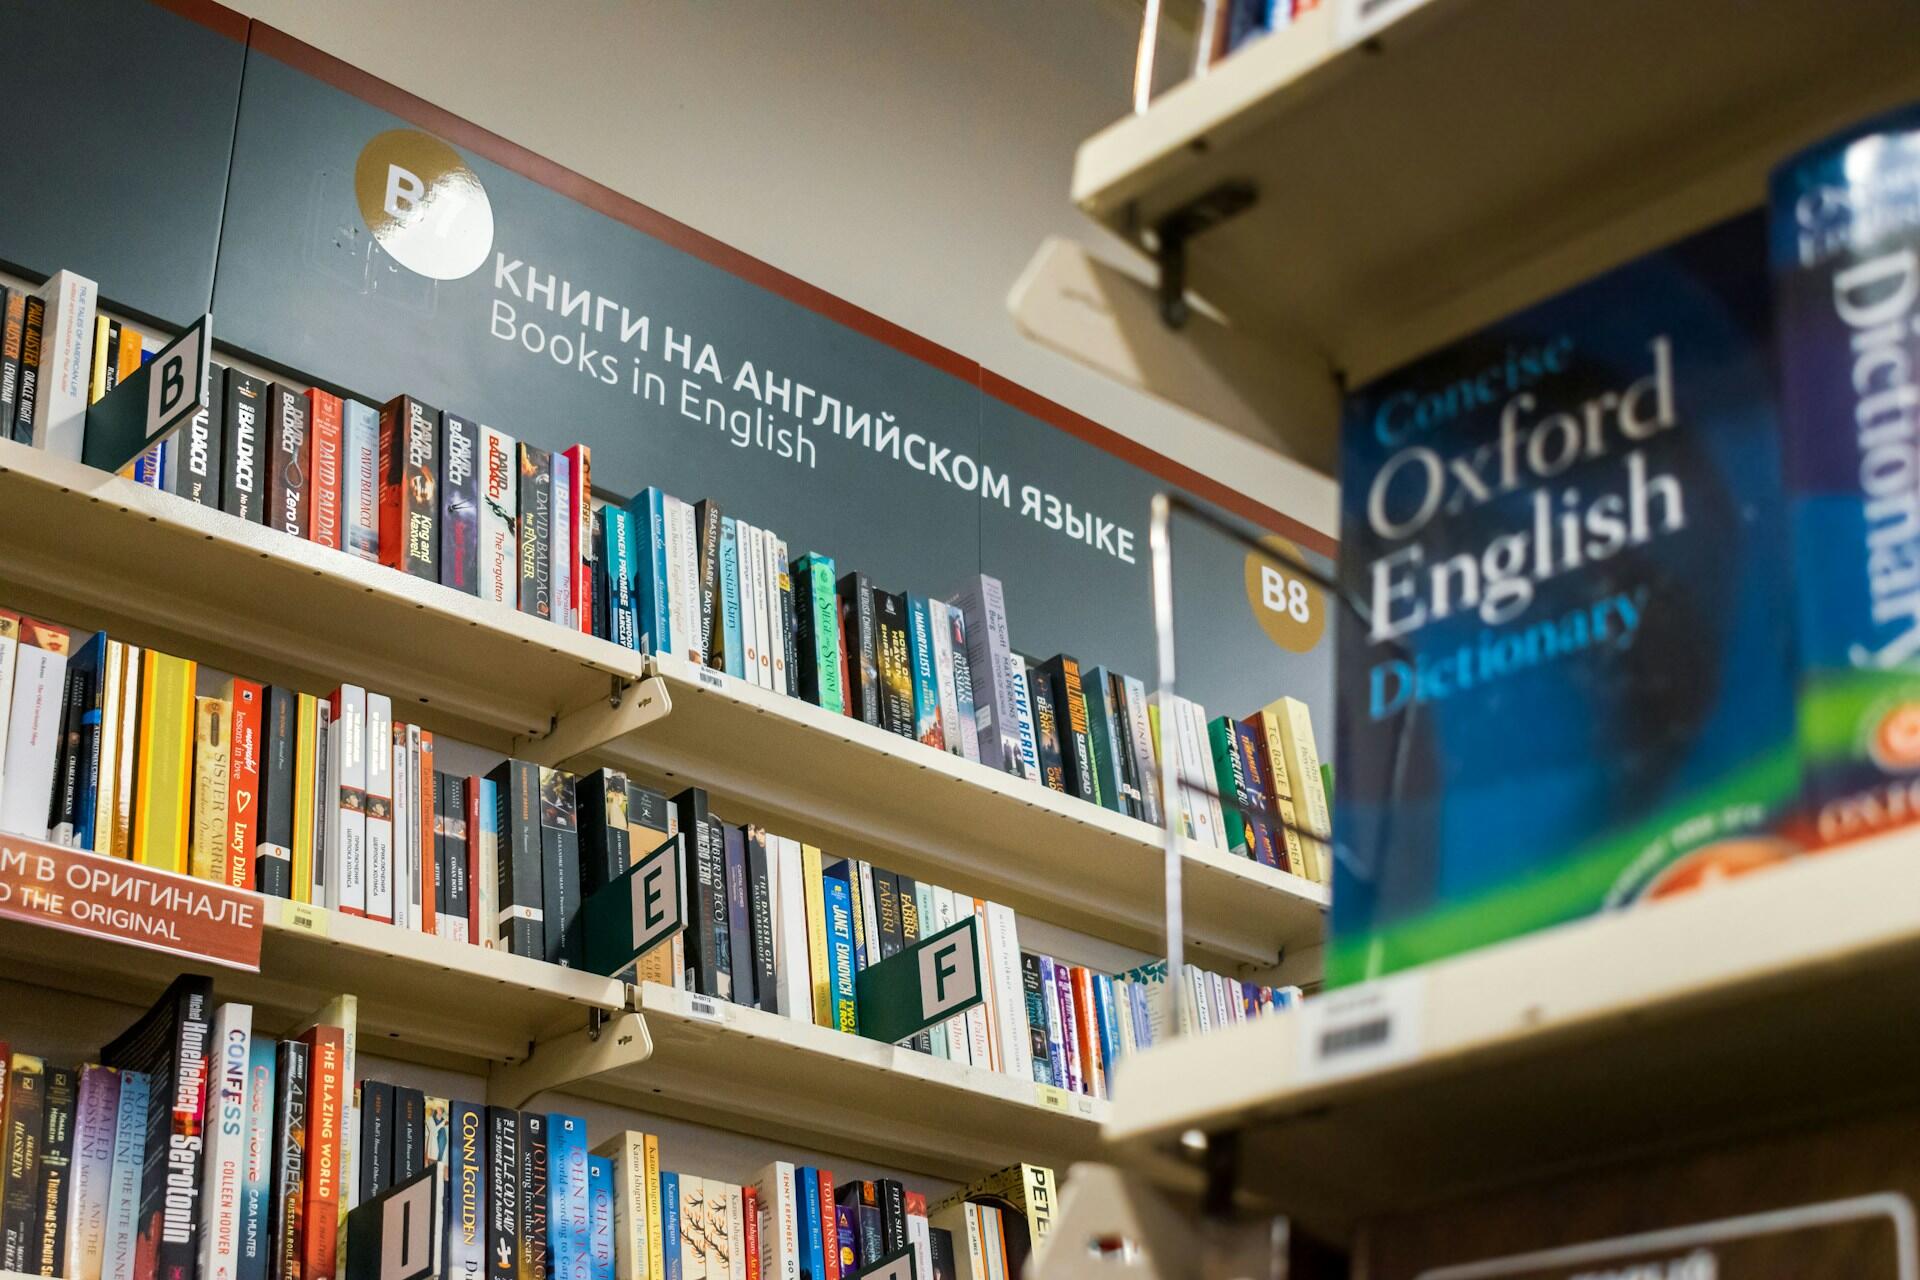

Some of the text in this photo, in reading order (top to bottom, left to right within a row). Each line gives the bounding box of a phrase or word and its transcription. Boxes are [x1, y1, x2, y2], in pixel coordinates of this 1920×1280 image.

[76, 306, 85, 328] TALES
[79, 286, 87, 306] TRUE
[4, 318, 20, 360] AUSTER
[19, 302, 43, 425] PAUL AUSTER ORACLE NIGHT
[72, 341, 82, 381] AMERICAN
[69, 381, 78, 398] LIFE
[160, 355, 184, 418] B
[490, 299, 816, 469] Books in English
[494, 252, 1136, 564] КНИГИ НА АНГЛИЙСКОМ ЯЗЫКЕ
[1374, 335, 1575, 447] Concise
[236, 408, 255, 493] BALDACCI
[319, 437, 336, 486] DAVID
[410, 402, 422, 468] BALDACCI
[421, 419, 432, 461] DAVID
[449, 418, 462, 486] BALDACCI
[461, 435, 472, 478] DAVID
[489, 434, 500, 500] BALDACCI
[1366, 335, 1677, 540] Oxford
[360, 446, 372, 528] DAVID BALDACCI
[498, 451, 509, 490] DAVID
[286, 488, 300, 520] Zero
[410, 511, 421, 558] Maxwell
[537, 489, 548, 541] DAVID
[492, 531, 505, 603] The Forgotten
[616, 513, 631, 608] BROKEN PROMISE
[723, 545, 737, 600] Sebastian
[1367, 450, 1685, 642] English
[701, 507, 718, 661] SEBASTIAN BARRY DAYS WITHOUT
[1261, 566, 1310, 624] B8
[625, 610, 634, 650] LINWOOD
[914, 610, 931, 682] IMMORTALISTS
[1368, 584, 1649, 720] Dictionary
[824, 648, 836, 693] STORM
[1012, 673, 1036, 769] STEVE BERRY
[1036, 695, 1050, 738] BERRY
[1065, 674, 1088, 734] BILLINGHAM
[233, 710, 247, 780] lessons love
[1076, 733, 1092, 795] SLEEPYHEAD
[1273, 749, 1288, 787] BOYLE
[65, 755, 77, 816] CHARLES DICKENS
[212, 753, 226, 813] SISTER
[232, 820, 248, 857] Lucy
[696, 819, 709, 860] NUMERO
[710, 826, 723, 890] UMBERTO
[1, 848, 254, 929] М В ОРИГИНАЛЕ
[644, 865, 664, 930] E
[698, 858, 712, 886] ZERO
[20, 886, 65, 915] THE
[71, 900, 181, 941] ORIGINAL
[713, 892, 724, 921] ECO
[753, 884, 765, 964] DAVID EBERSHOFF
[759, 874, 773, 977] THE DANISH GIRL
[879, 880, 895, 934] FABBRI
[901, 892, 916, 939] FABBRI
[832, 904, 853, 996] JANET EVANOVICH
[935, 943, 956, 1003] F
[188, 993, 204, 1021] Michel
[846, 999, 855, 1027] TWO
[172, 1019, 208, 1115] Houellebecq
[222, 1028, 247, 1137] CONFESS
[11, 1120, 25, 1179] HOSSEINI
[97, 1086, 115, 1161] KHALED
[116, 1090, 135, 1165] HOSSEINI
[131, 1090, 149, 1166] KHALED
[318, 1041, 336, 1198] THE BLAZING WORLD
[25, 1134, 35, 1171] KHALED
[462, 1110, 480, 1246] CONN IGGULDEN
[494, 1134, 503, 1198] STRUCK LUCKY
[502, 1127, 516, 1236] LITTLE OLD LADY
[632, 1143, 643, 1214] Kazuo Ishiguro
[648, 1146, 658, 1216] Kazuo Ishiguro
[41, 1178, 61, 1264] THOUSAND SPLENDID
[117, 1168, 135, 1230] THE KITE
[163, 1134, 201, 1244] Serotonin
[216, 1161, 236, 1258] COLLEEN HOOVER
[287, 1197, 297, 1235] RUSSIAN
[522, 1151, 535, 1264] setting free the bears
[532, 1141, 547, 1280] JOHN IRVING
[558, 1153, 571, 1241] world according
[571, 1145, 587, 1279] JOHN IRVING
[596, 1188, 609, 1239] JOHN
[667, 1183, 676, 1247] Kazuo Ishiguro
[892, 1186, 902, 1216] FIFTY
[87, 1232, 98, 1256] THE
[246, 1188, 259, 1259] CARA HUNTER
[748, 1197, 758, 1255] Kazuo Ishiguro
[783, 1172, 795, 1274] JENNY ERPENBECK GO
[823, 1181, 837, 1268] TOVE JANSSON
